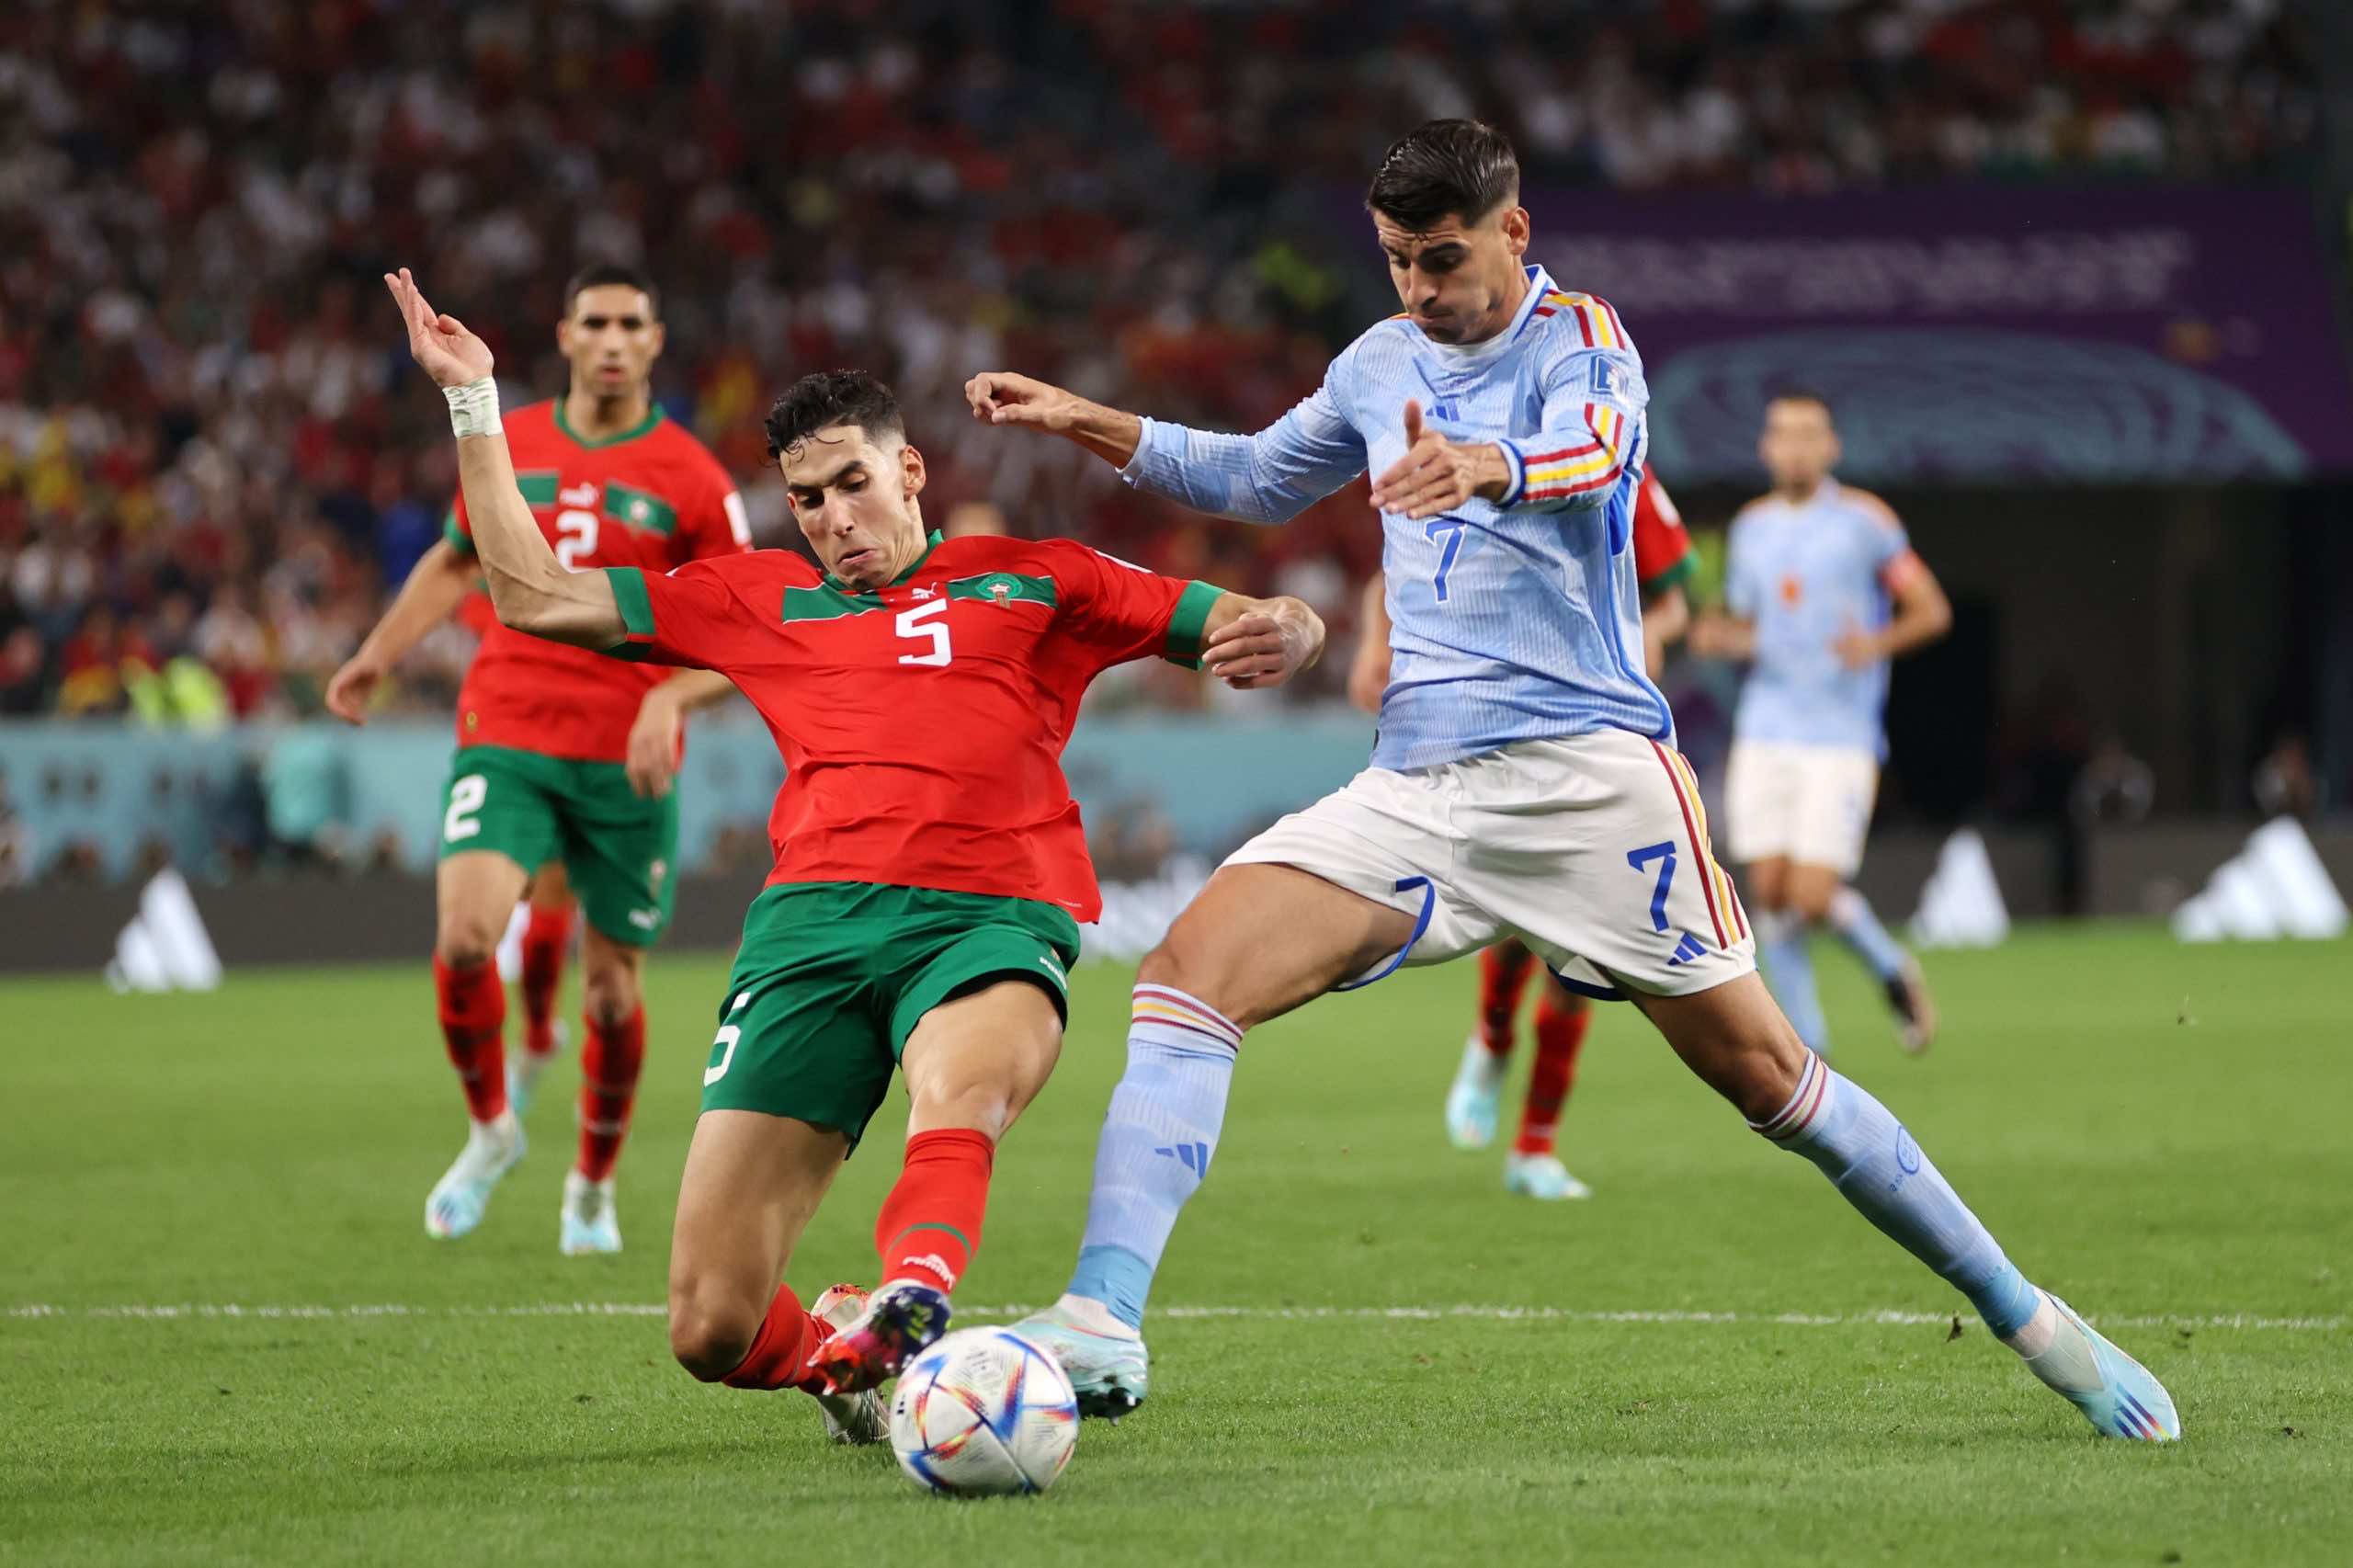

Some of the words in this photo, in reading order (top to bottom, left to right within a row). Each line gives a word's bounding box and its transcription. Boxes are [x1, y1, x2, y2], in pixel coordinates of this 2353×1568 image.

[555, 509, 598, 574] 2
[1423, 517, 1467, 604] 7
[895, 597, 952, 667] 5
[443, 773, 488, 844] 2
[1626, 840, 1677, 933] 7
[703, 992, 751, 1088] 5
